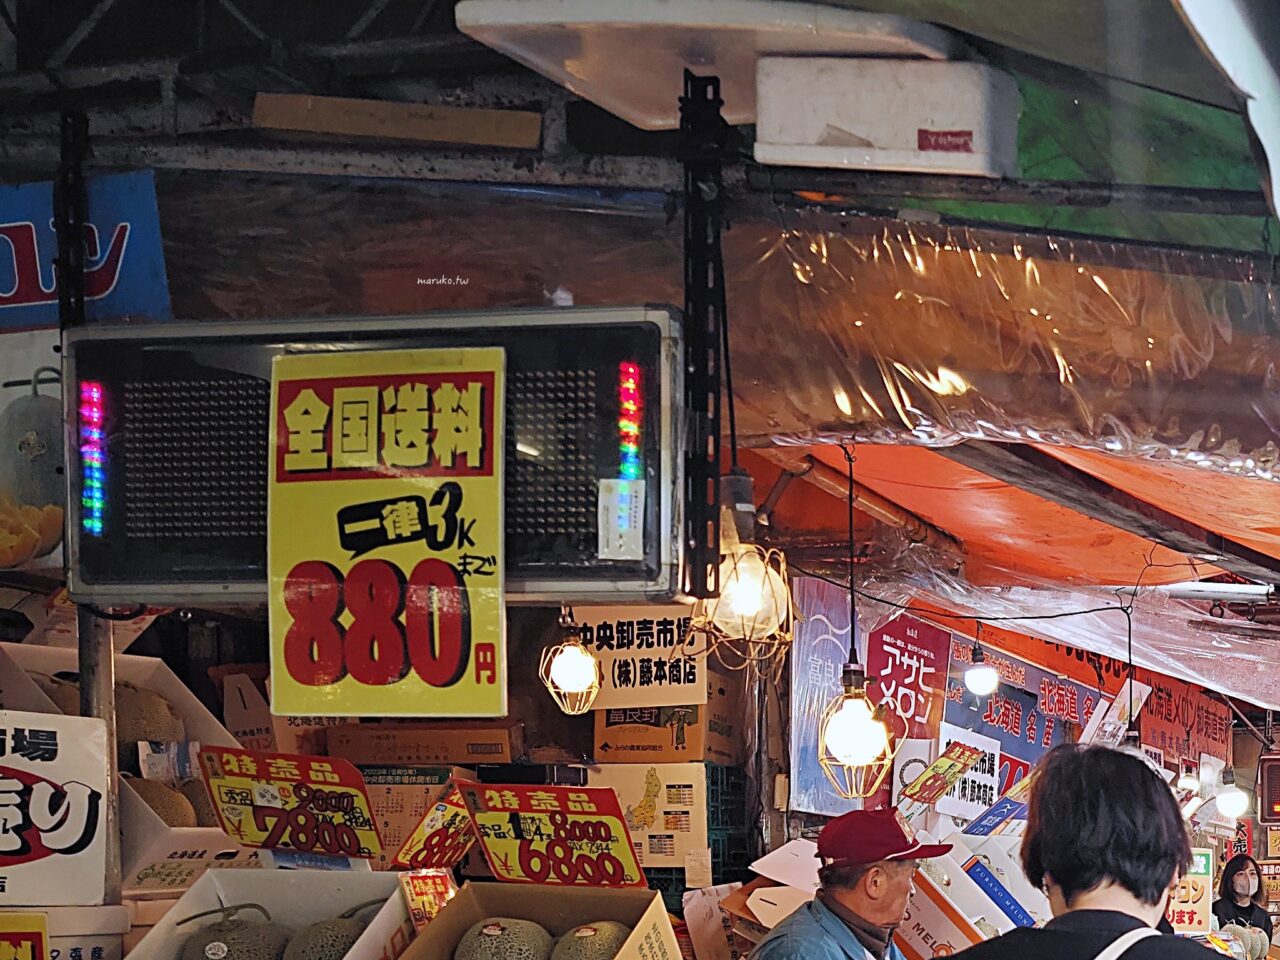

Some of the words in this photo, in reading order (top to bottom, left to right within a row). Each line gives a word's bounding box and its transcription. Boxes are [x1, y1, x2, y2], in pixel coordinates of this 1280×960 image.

[283, 381, 486, 473] 全国送料
[457, 553, 497, 578] まで
[284, 558, 471, 687] 880
[474, 642, 497, 684] 円
[579, 617, 696, 650] 中央卸売市場
[612, 656, 697, 689] (株)藤本商店
[881, 644, 936, 694] アサヒ
[880, 680, 933, 724] メロン
[222, 752, 340, 784] 特売品
[385, 787, 392, 795] 2
[485, 790, 598, 812] 特売品
[975, 866, 1004, 899] FURANO
